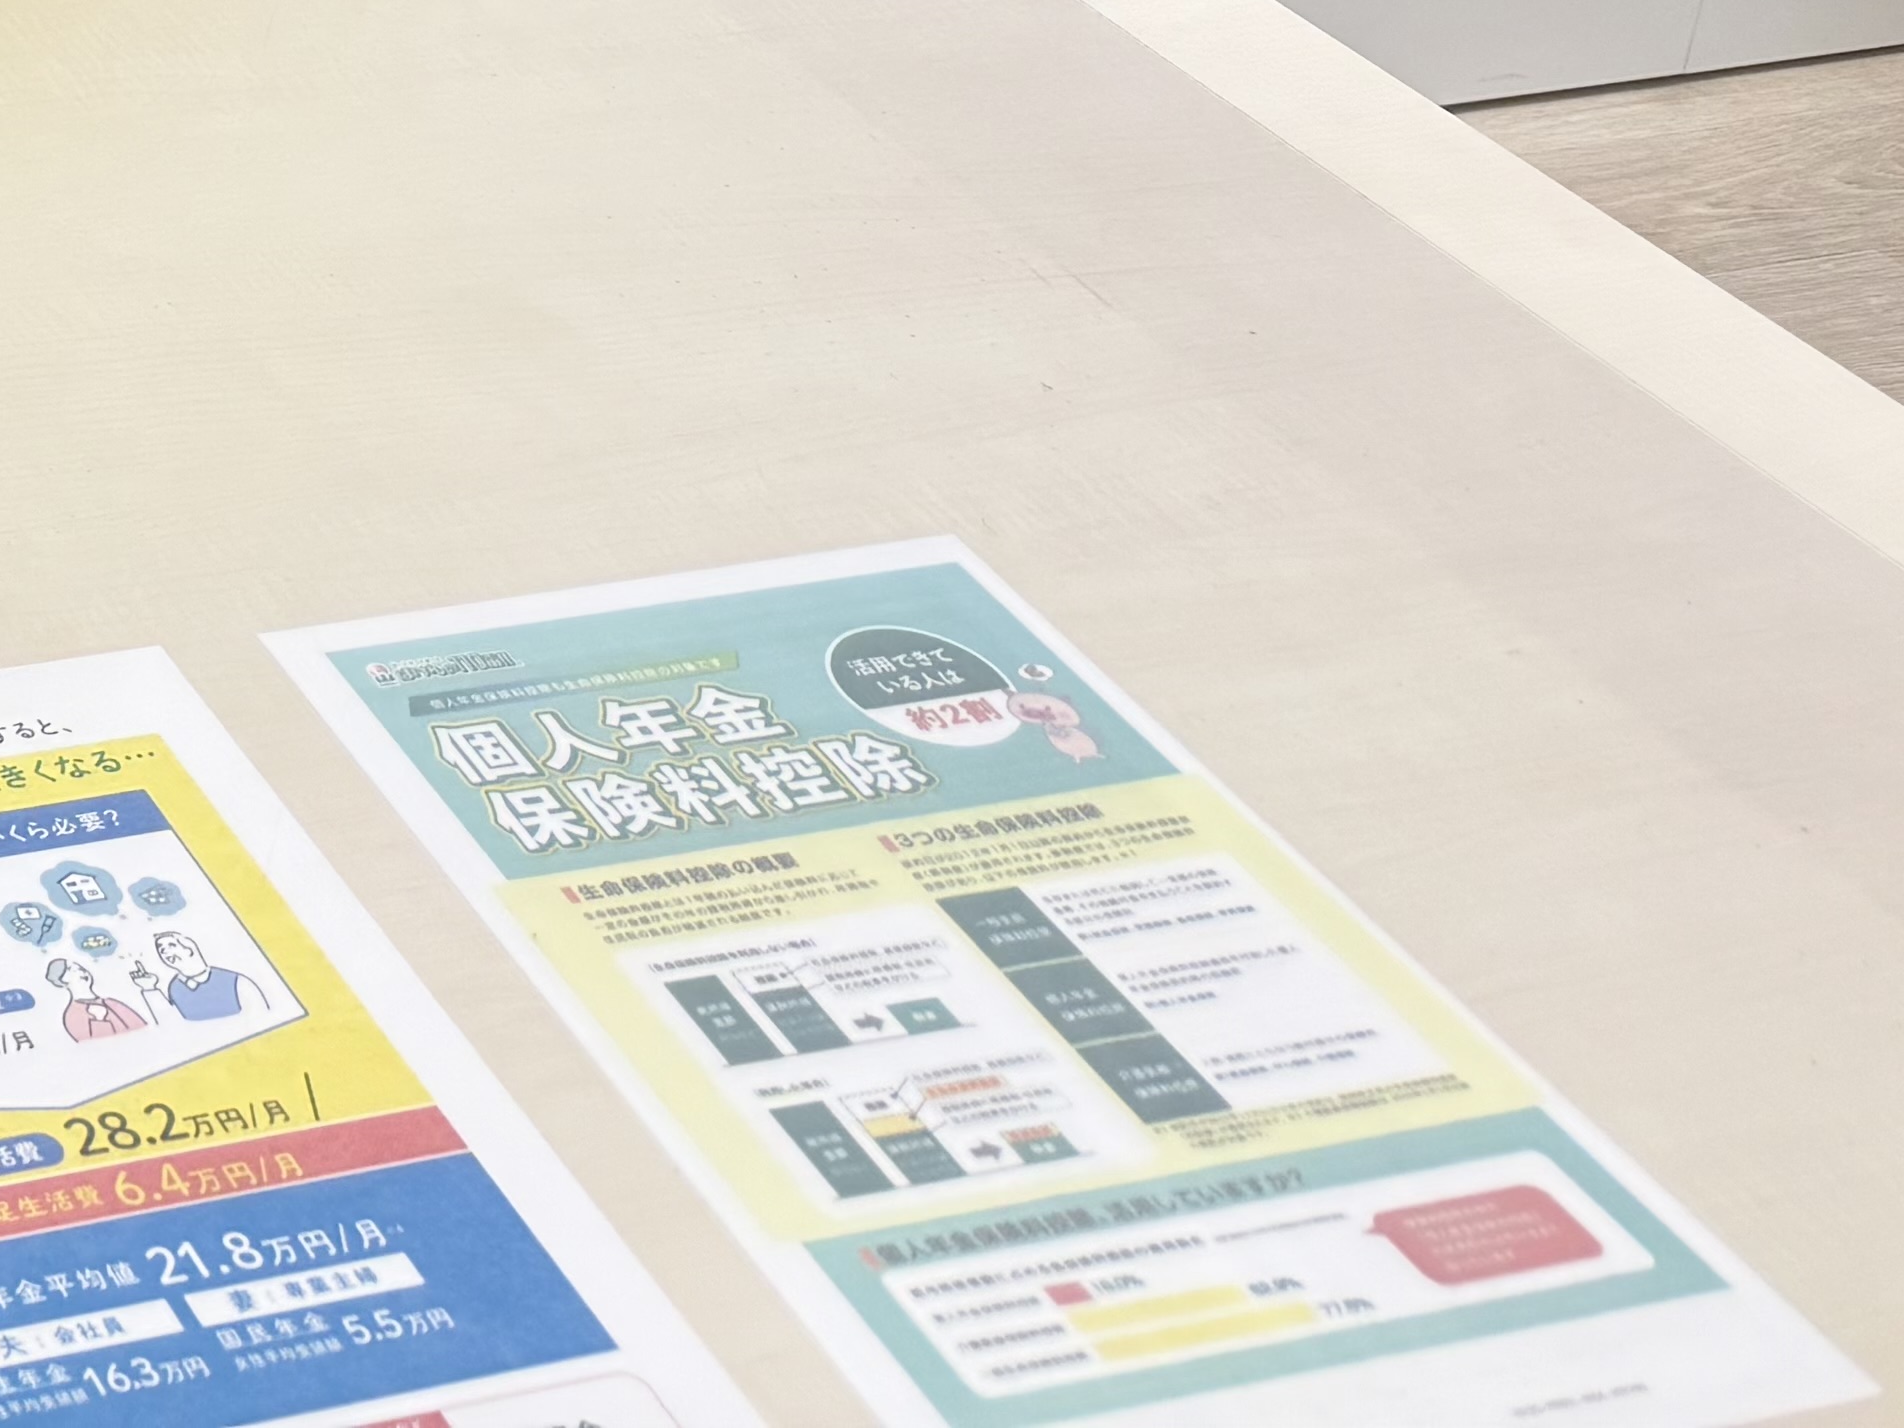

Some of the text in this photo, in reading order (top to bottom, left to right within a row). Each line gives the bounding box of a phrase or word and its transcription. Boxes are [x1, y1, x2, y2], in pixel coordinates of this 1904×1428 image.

[847, 647, 953, 677] 活用できて
[876, 668, 966, 694] いる人は
[435, 687, 792, 783] 個人年金
[905, 696, 1004, 732] 約2割
[489, 735, 934, 850] 保険料控除
[892, 802, 1105, 849] 3つの生命保険料控除
[577, 851, 801, 902] 生命保険料控除の概要
[64, 1100, 292, 1158] 28.2万円/月
[113, 1152, 304, 1208] 6.4万円/月
[215, 1306, 456, 1351] 国民年金 5.5万円
[82, 1355, 211, 1396] 16.3万円
